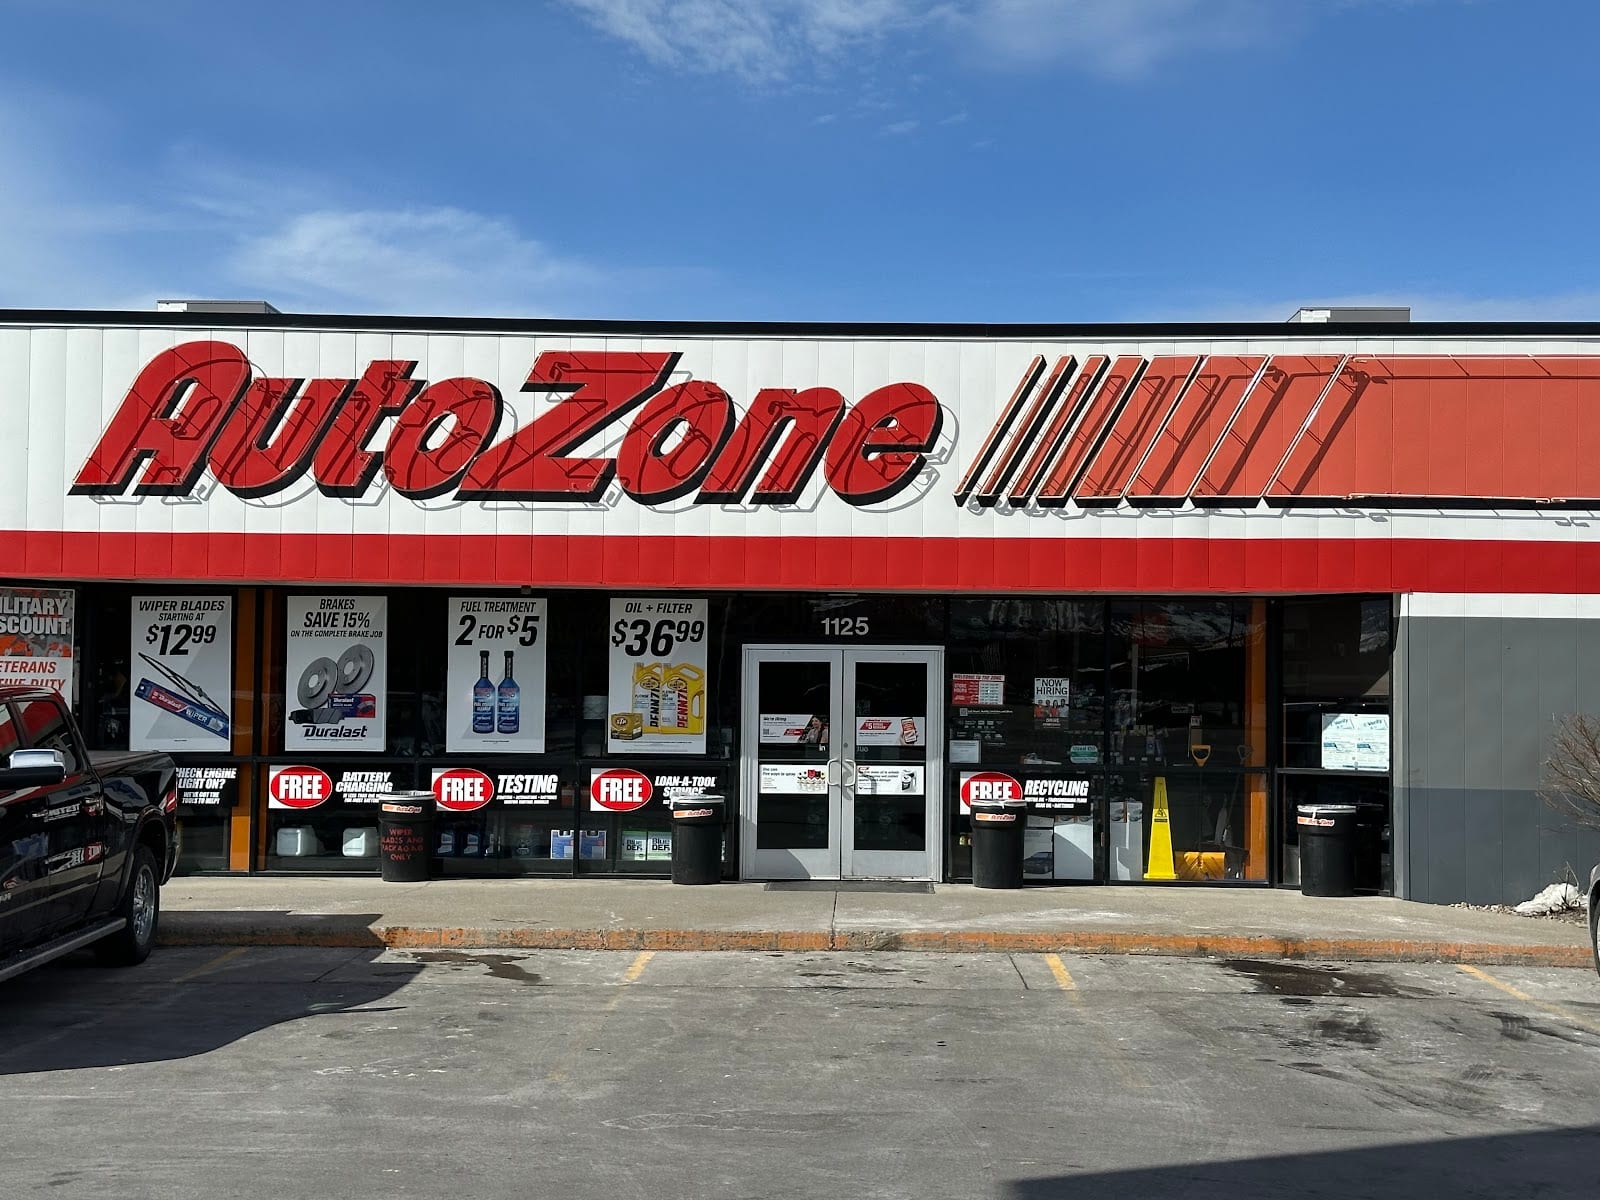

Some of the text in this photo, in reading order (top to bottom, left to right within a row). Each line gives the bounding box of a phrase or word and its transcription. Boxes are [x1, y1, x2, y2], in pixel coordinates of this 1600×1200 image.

[69, 340, 943, 507] AutoZone
[139, 600, 225, 612] WIPER BLADES
[319, 599, 355, 610] BRAKES
[460, 601, 537, 613] FUEL TREATMENT
[625, 602, 642, 613] OIL
[656, 602, 693, 614] FILTER
[158, 612, 205, 622] STARTING AT
[304, 612, 370, 628] SAVE 15%
[455, 614, 540, 647] 2 FOR $5
[821, 617, 869, 636] 1125
[290, 630, 383, 638] ON THE COMPLETE BRAKE JOB
[1041, 679, 1063, 687] NOW
[1036, 687, 1068, 696] HIRING
[185, 708, 208, 723] WIPER
[302, 724, 368, 738] Duralast
[203, 767, 237, 779] ENGINE
[342, 772, 391, 782] BATTERY
[178, 778, 226, 789] LIGHT ON?
[279, 775, 323, 799] FREE
[335, 781, 394, 793] CHARGING
[496, 775, 558, 793] TESTING
[655, 776, 716, 787] LOAN-A-TOOL
[441, 777, 485, 802] FREE
[600, 778, 643, 803] FREE
[969, 781, 1013, 800] FREE
[1024, 780, 1089, 796] RECYCLING
[652, 837, 671, 845] Blue
